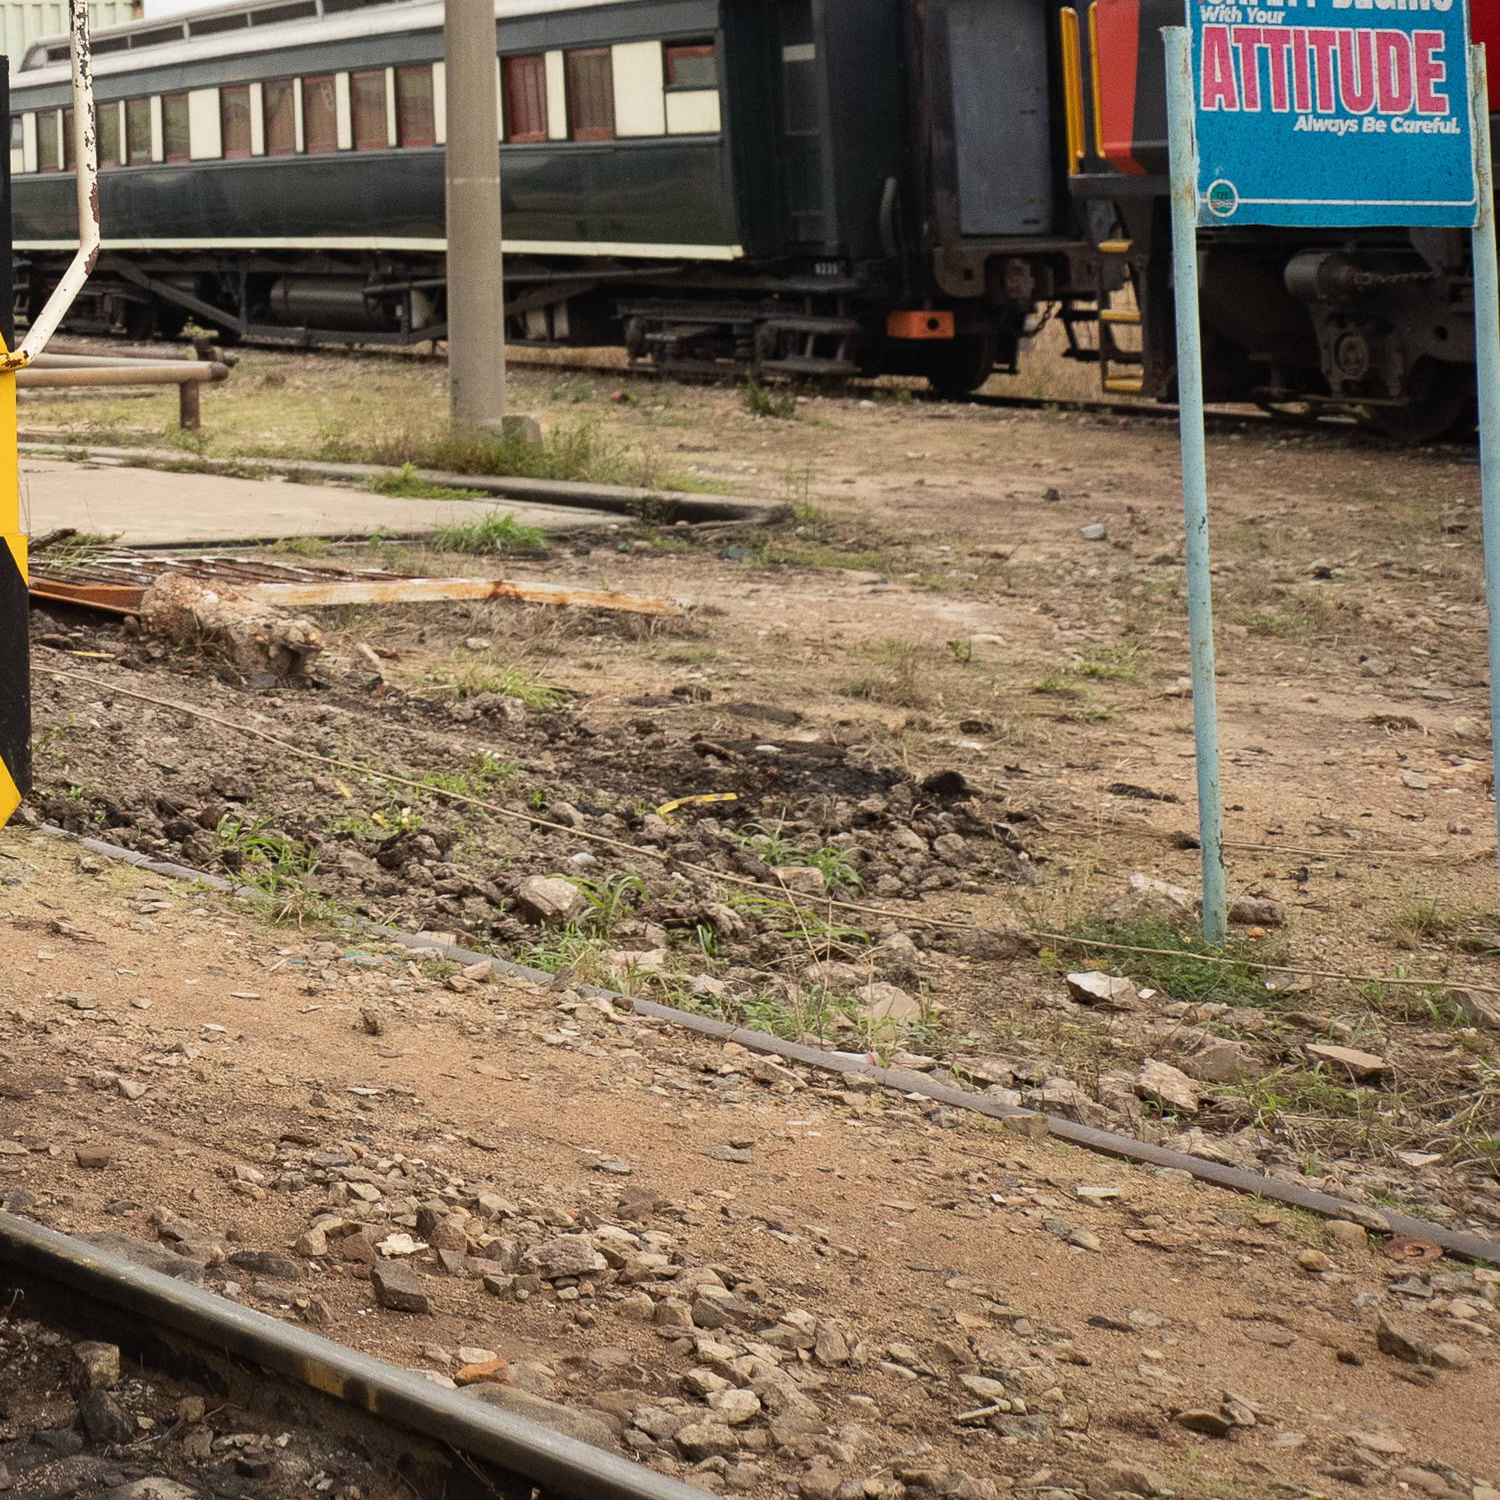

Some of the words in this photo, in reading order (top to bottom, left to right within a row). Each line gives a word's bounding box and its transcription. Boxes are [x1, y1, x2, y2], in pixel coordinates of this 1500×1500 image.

[1201, 5, 1242, 24] With
[1247, 7, 1286, 25] Your
[1200, 24, 1450, 116] ATTITUDE
[1293, 115, 1359, 136] Always
[1362, 117, 1387, 133] Be
[1391, 117, 1462, 135] Careful.
